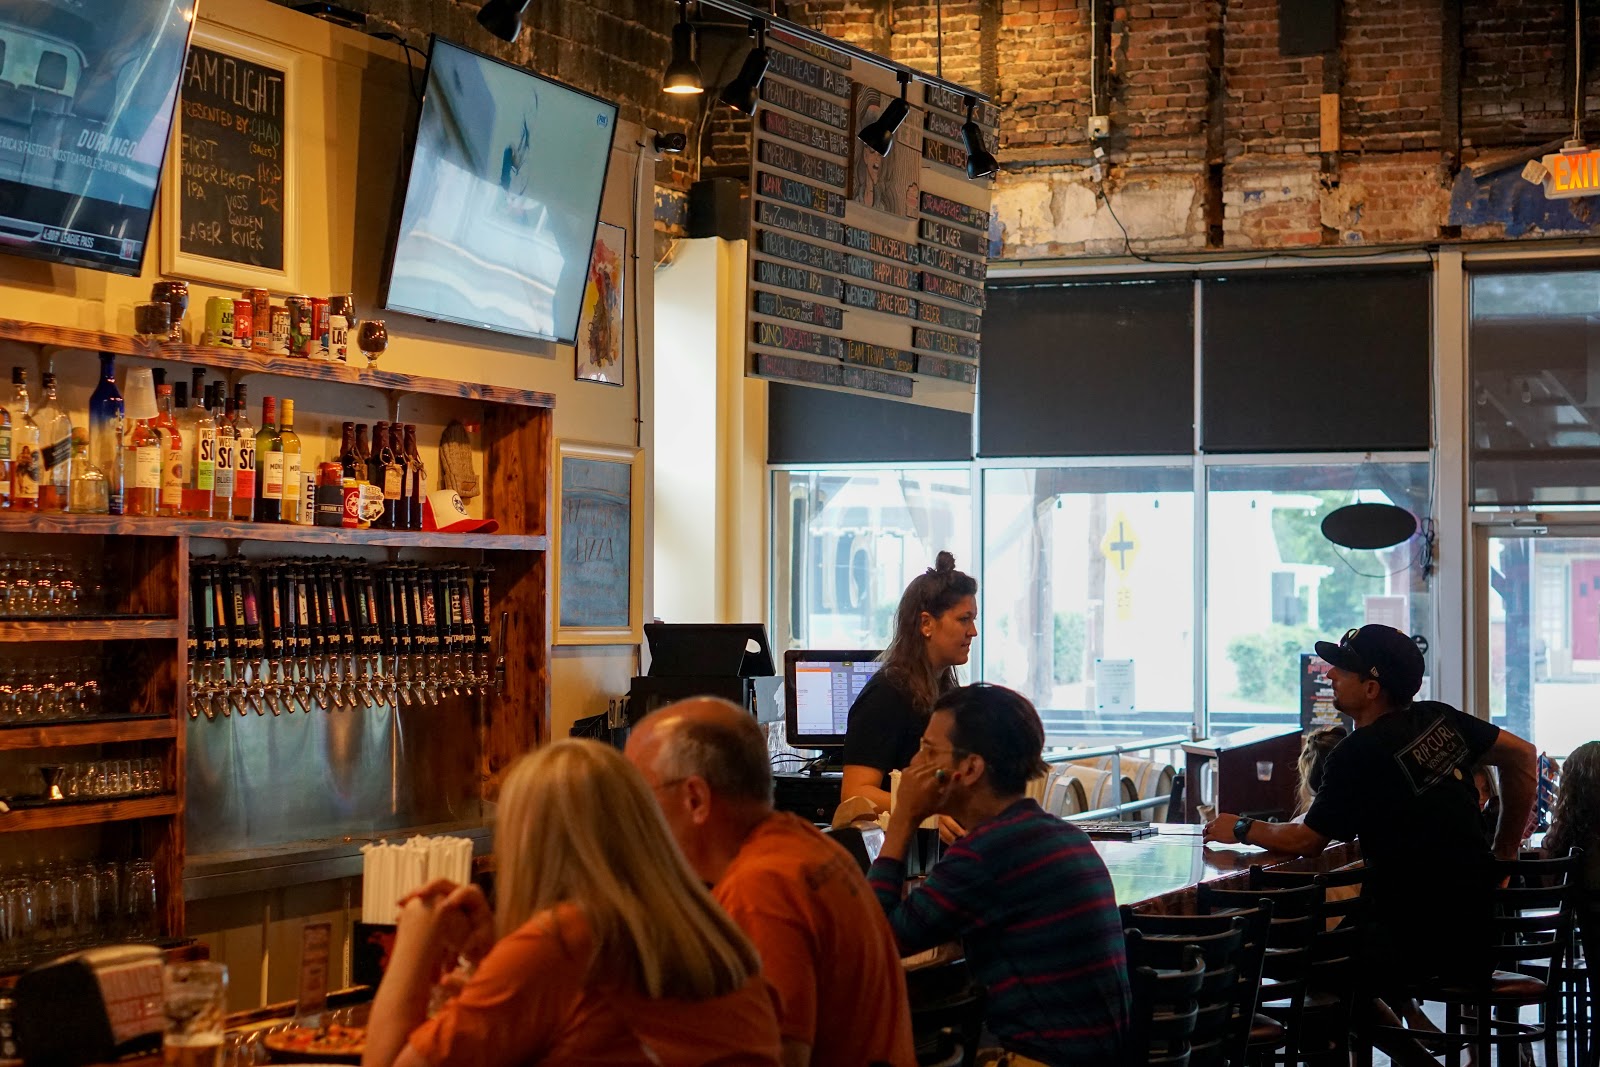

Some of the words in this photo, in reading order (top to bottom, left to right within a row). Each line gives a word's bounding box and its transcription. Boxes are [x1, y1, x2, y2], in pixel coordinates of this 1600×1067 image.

[770, 49, 821, 85] SOUTHEAST
[823, 69, 834, 91] IPA
[223, 58, 282, 116] FLIGHT
[766, 80, 794, 109] PEANUT
[795, 89, 821, 117] BUTTER
[77, 129, 138, 158] DURANGO
[251, 118, 281, 147] CHAD
[812, 137, 829, 150] STOUT
[53, 149, 71, 163] MOST
[181, 134, 219, 161] FIRST
[928, 139, 944, 162] RYE
[1554, 152, 1599, 191] EXIT
[186, 179, 206, 201] IPA
[762, 173, 783, 197] DANK
[784, 179, 812, 206] SESSION
[225, 195, 250, 214] VOSS
[760, 202, 774, 226] NEW
[813, 198, 827, 212] ALE
[60, 231, 81, 246] LEAGUE
[80, 235, 96, 249] PASS
[870, 234, 888, 256] LUNCH
[924, 220, 939, 242] LIME
[941, 226, 962, 248] LAGER
[921, 245, 939, 266] WEST
[939, 250, 957, 273] COAST
[761, 263, 781, 285] DANK
[787, 267, 808, 289] PINEY
[809, 272, 823, 295] IPA
[873, 261, 892, 285] HAPPY
[894, 267, 909, 289] HOUR
[760, 323, 782, 347] DINO
[847, 340, 865, 362] TEAM
[1411, 743, 1432, 766] RIP
[1426, 723, 1455, 752] CURL
